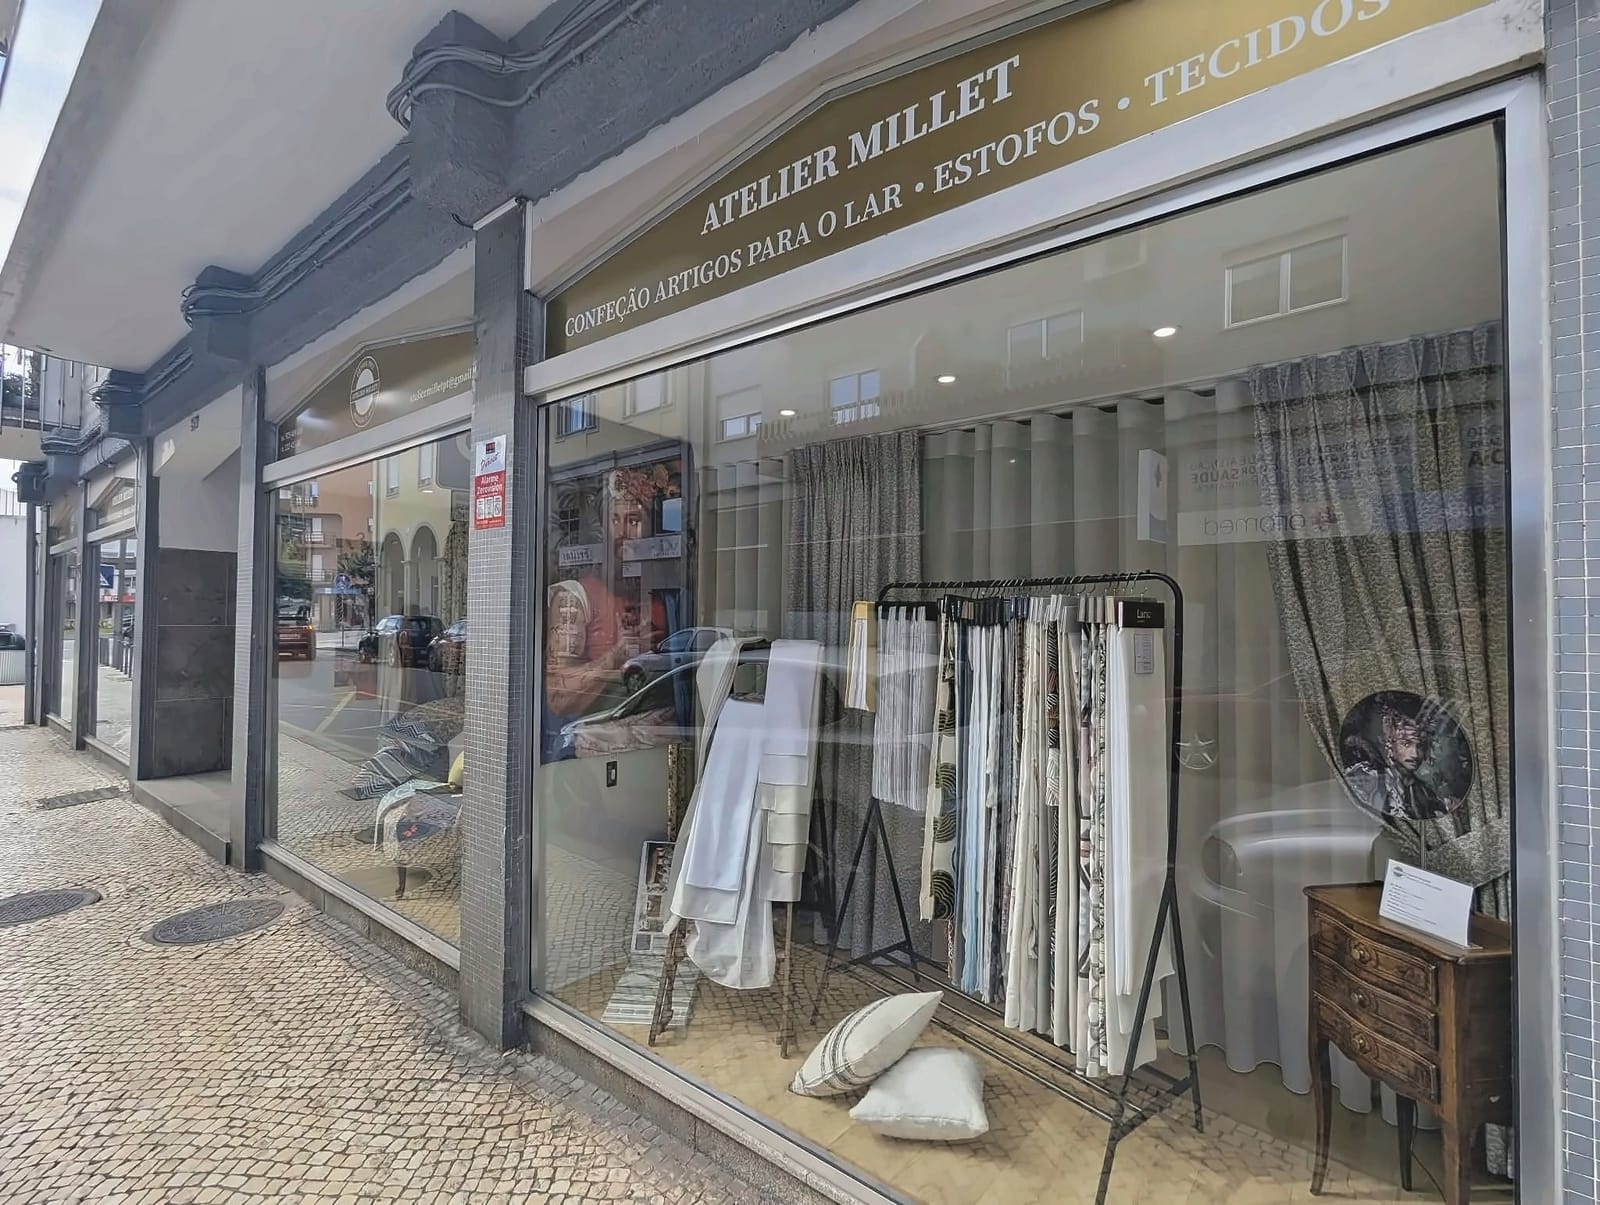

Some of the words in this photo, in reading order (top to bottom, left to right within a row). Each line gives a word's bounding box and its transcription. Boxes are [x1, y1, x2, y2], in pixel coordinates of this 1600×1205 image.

[565, 287, 651, 338] CONFEÇÃO
[654, 249, 743, 302] ARTIGOS
[747, 222, 812, 266] PARA
[817, 210, 838, 238] O
[844, 183, 903, 229] LAR
[933, 99, 1101, 193] ESTOFOS
[701, 145, 838, 235] ATELIER
[847, 55, 1020, 169] MILLET
